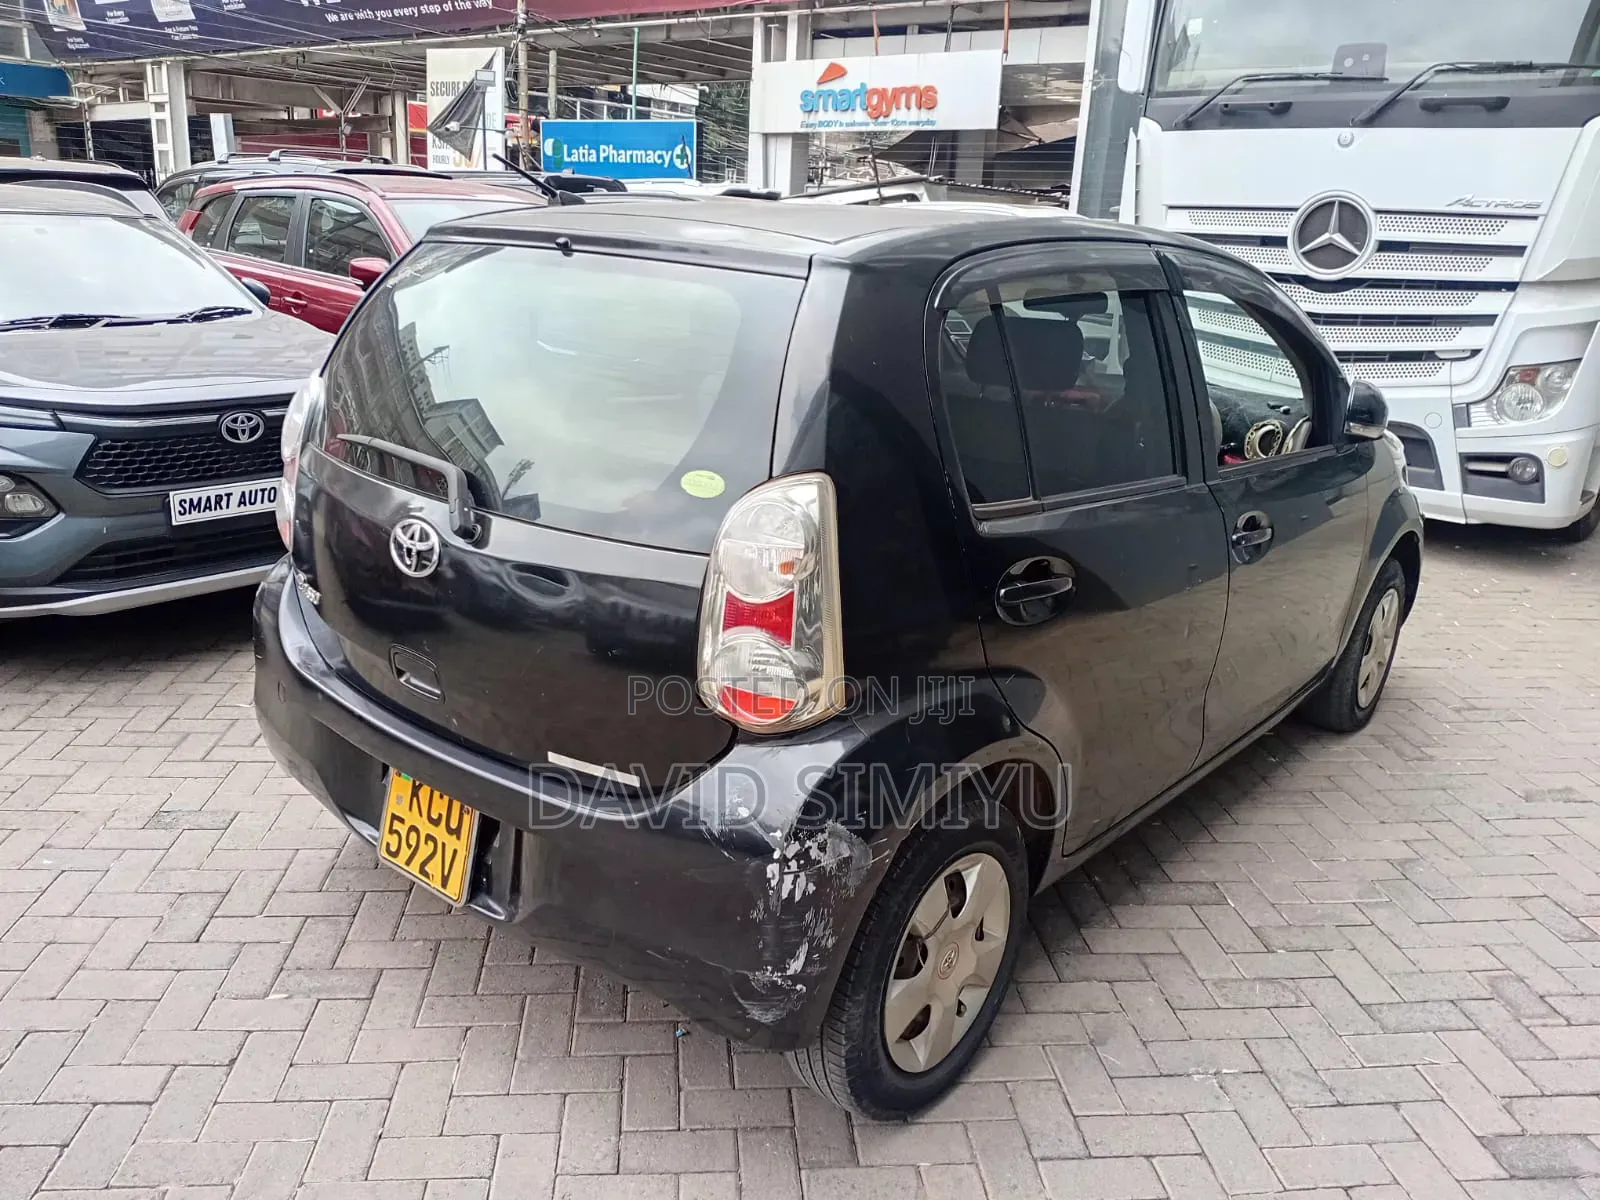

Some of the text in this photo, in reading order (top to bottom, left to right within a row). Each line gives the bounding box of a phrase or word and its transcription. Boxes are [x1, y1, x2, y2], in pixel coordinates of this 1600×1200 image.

[325, 0, 493, 23] We are with you every step of the way
[800, 82, 938, 119] smartgyms
[563, 143, 672, 168] Latia Pharmacy
[178, 486, 277, 516] SMART AUTO
[385, 812, 459, 890] 592V
